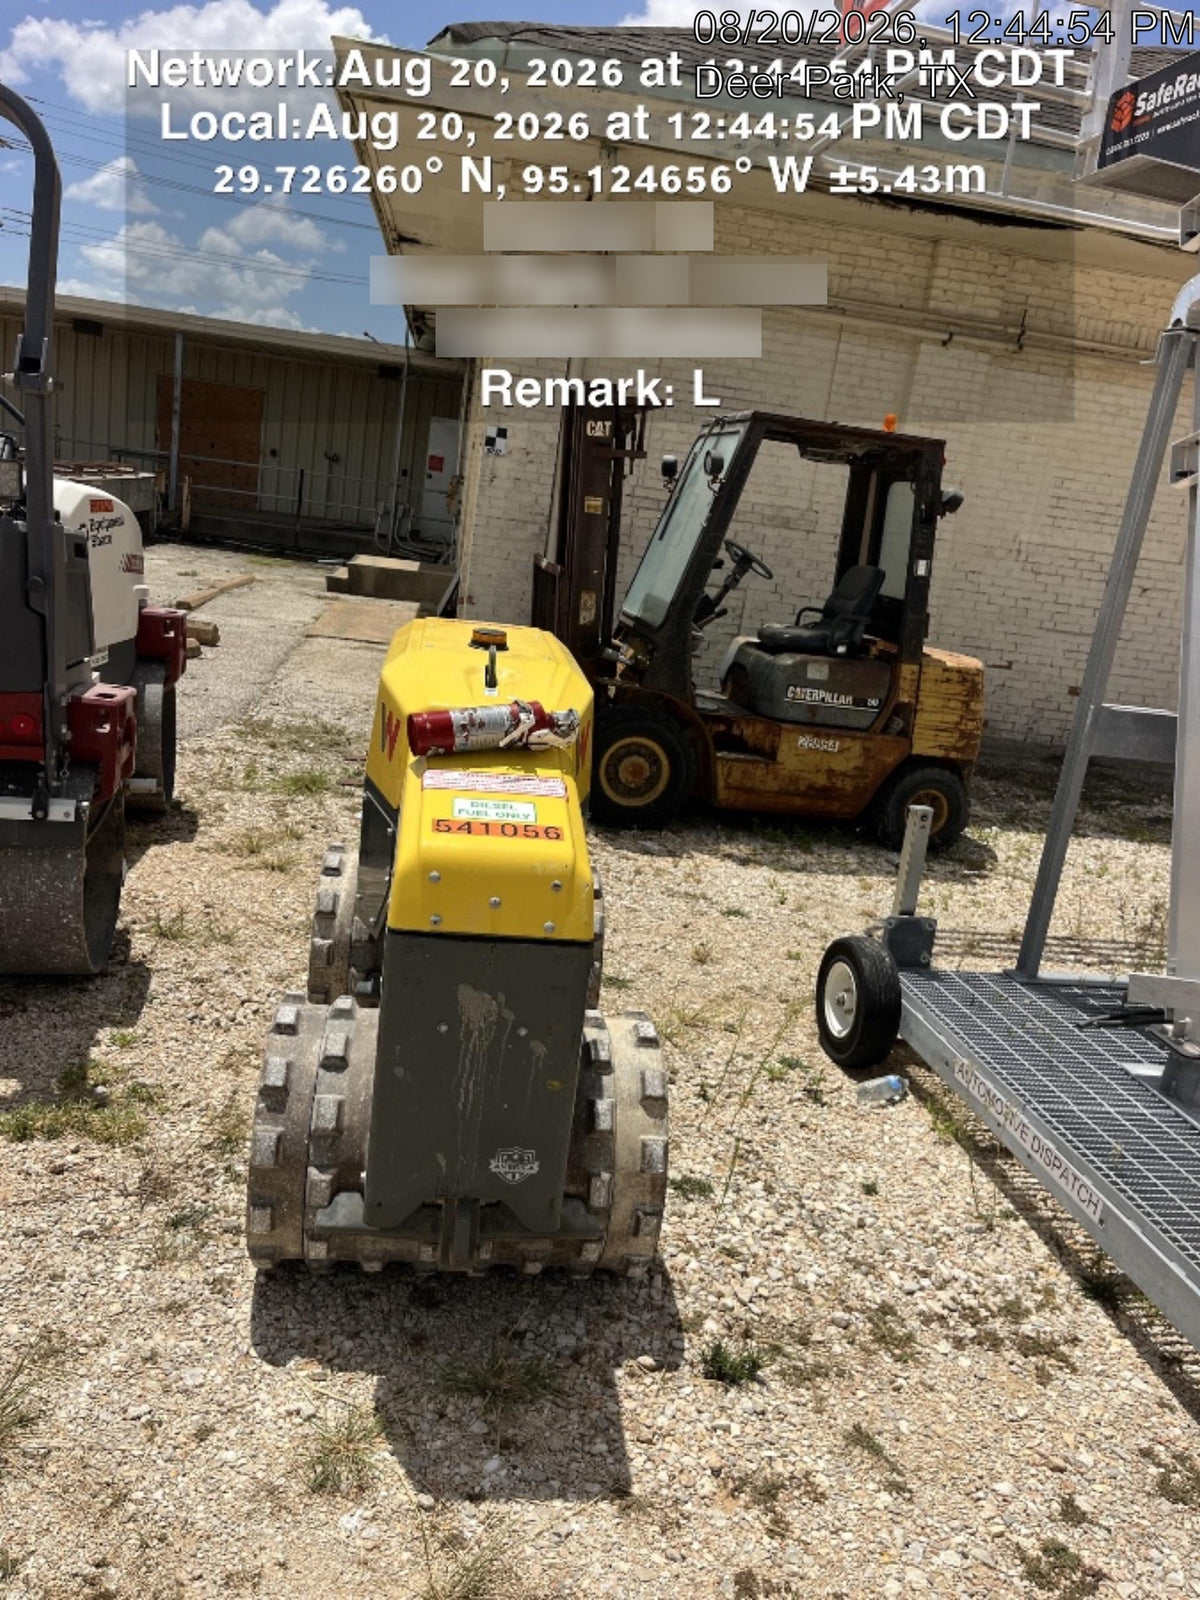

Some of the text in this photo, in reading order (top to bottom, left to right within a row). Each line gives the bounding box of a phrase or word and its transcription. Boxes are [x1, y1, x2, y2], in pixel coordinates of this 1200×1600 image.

[586, 420, 613, 438] CAT
[786, 685, 853, 705] CATERPILLAR
[457, 808, 532, 821] FUEL ONLY
[470, 801, 518, 812] DIESEL
[434, 818, 563, 841] 541056
[1030, 1135, 1100, 1216] DISPATCH
